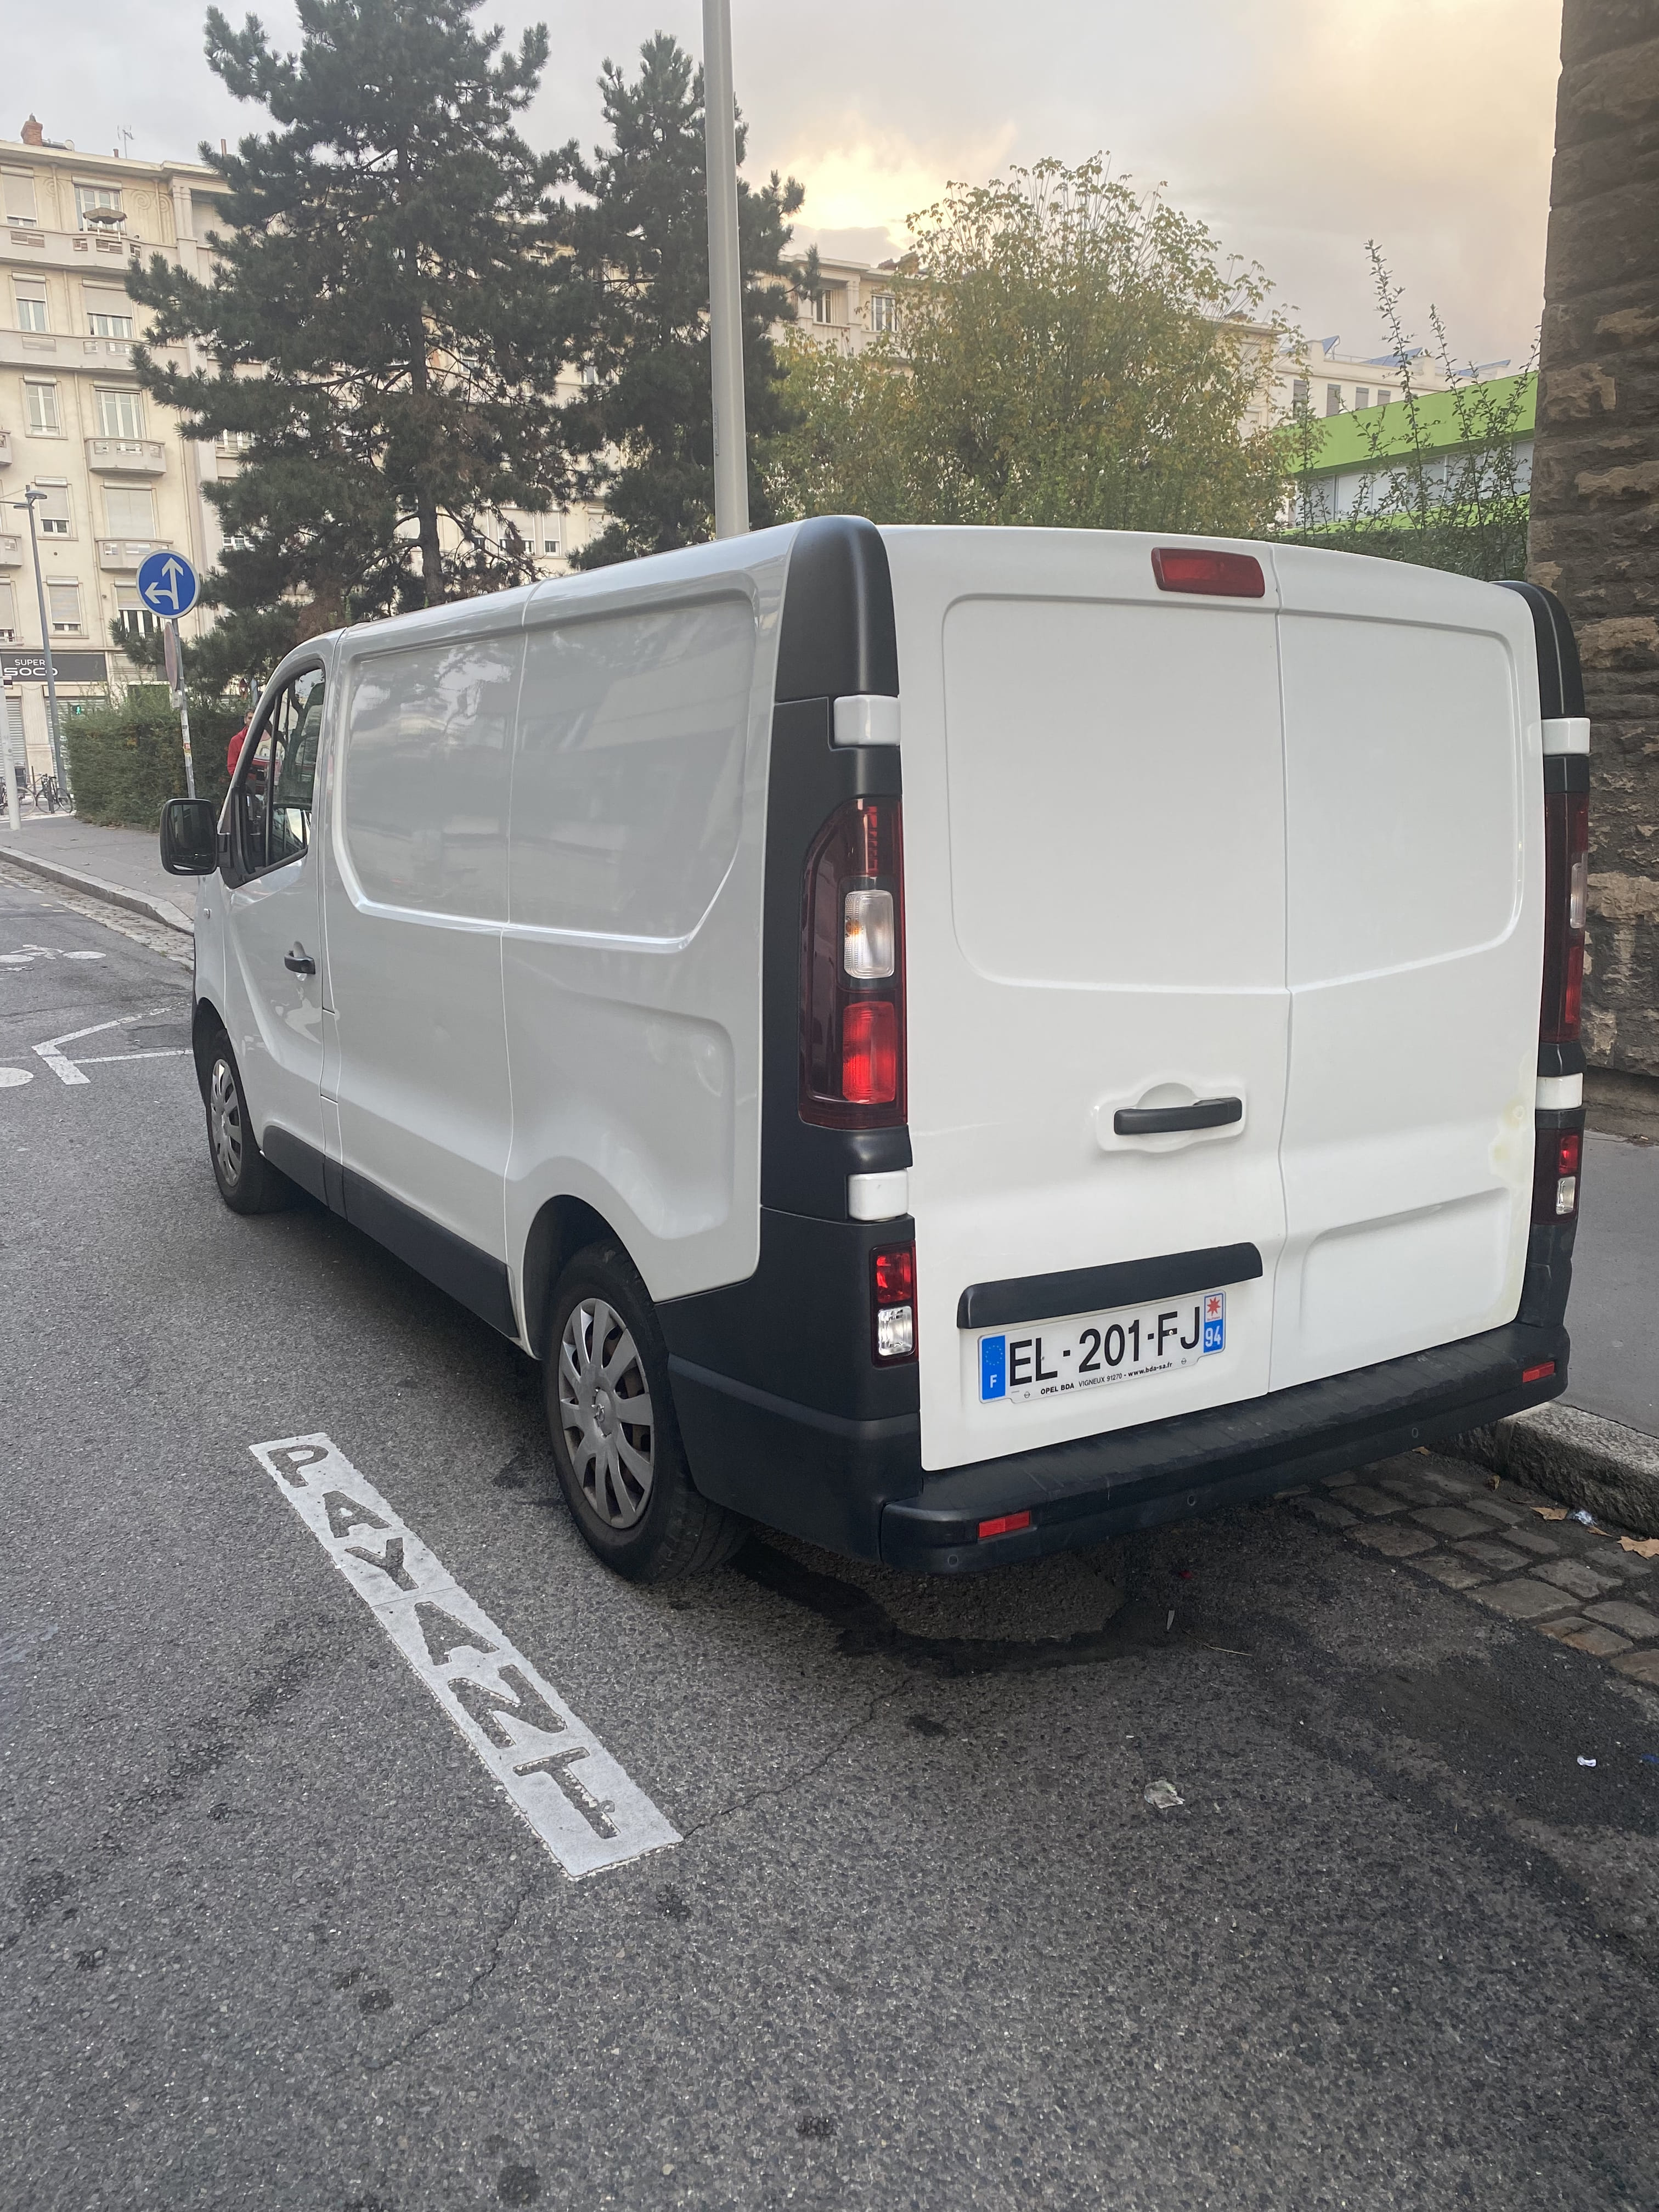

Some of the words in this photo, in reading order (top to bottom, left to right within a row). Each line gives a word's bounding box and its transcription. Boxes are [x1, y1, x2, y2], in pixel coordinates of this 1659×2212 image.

[1205, 1325, 1221, 1347] 94
[990, 1374, 997, 1388] F
[1040, 1386, 1058, 1395] OPEL
[1060, 1383, 1074, 1391] BDA
[1079, 1378, 1105, 1387] VIGNEUX
[1107, 1373, 1122, 1381] 91270
[1128, 1362, 1172, 1377] www.bda-sa.fr
[266, 1444, 622, 1840] PAYANT
